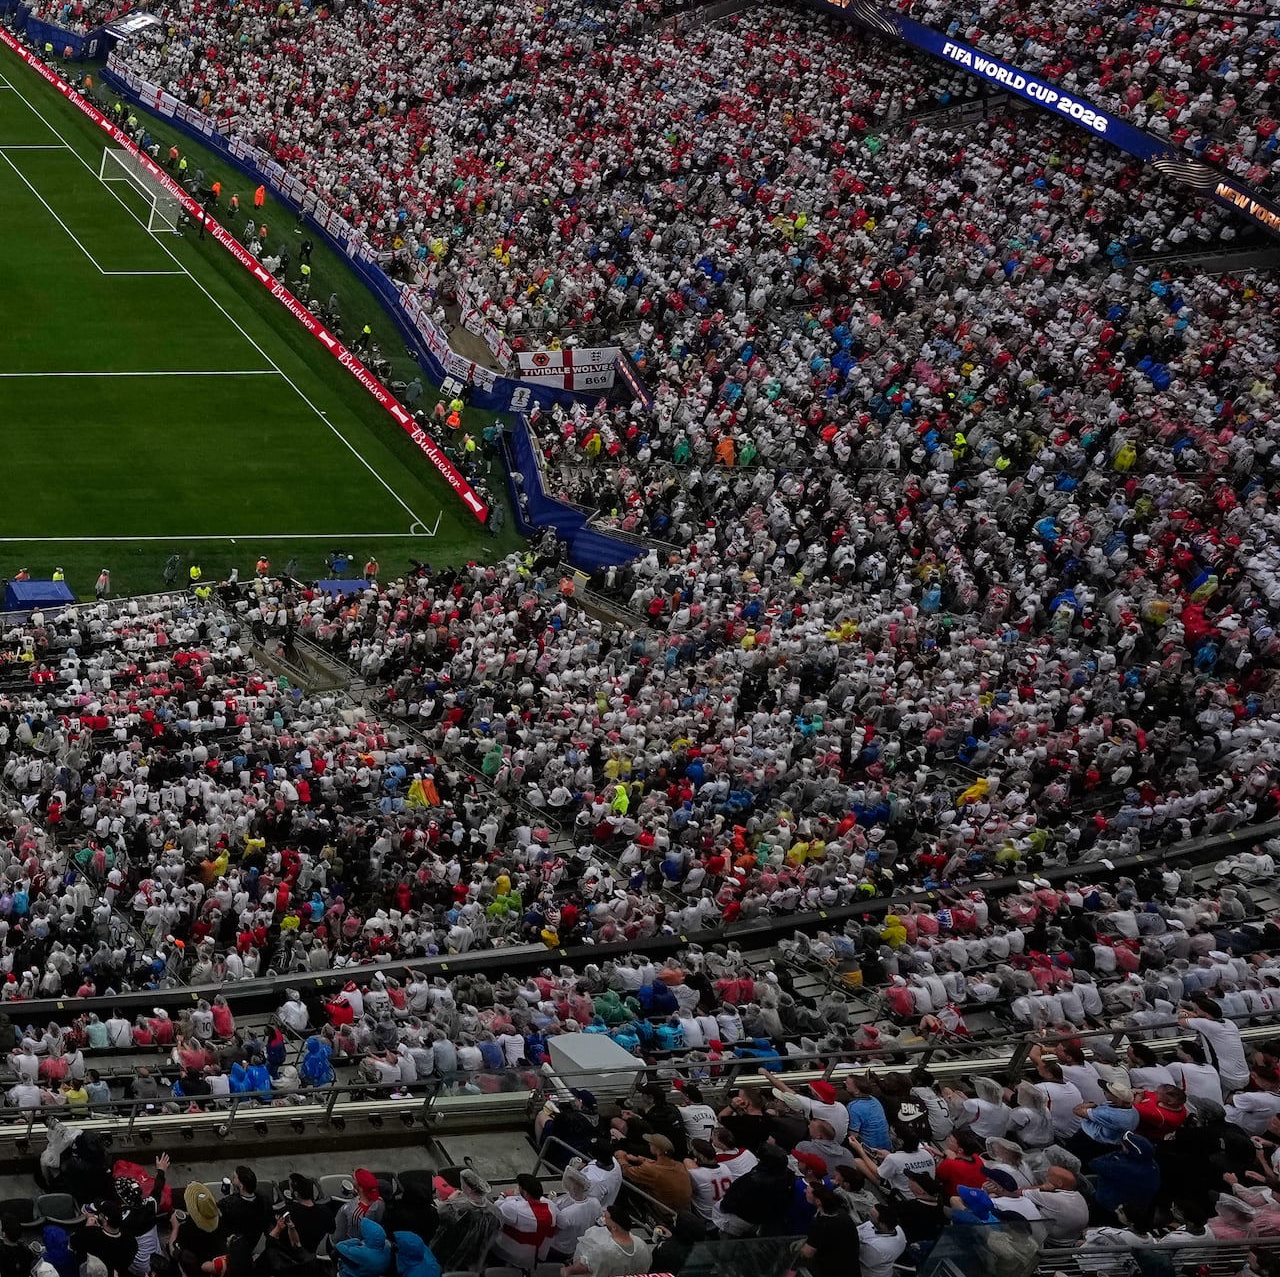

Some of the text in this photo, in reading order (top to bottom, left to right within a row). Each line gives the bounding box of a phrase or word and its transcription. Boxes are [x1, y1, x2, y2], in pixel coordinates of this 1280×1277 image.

[26, 51, 55, 82] Budweiser
[68, 88, 100, 122] Budweiser
[942, 42, 1108, 134] FIFA WORLD CUP 2026
[159, 172, 195, 212] Budweiser
[1214, 182, 1251, 210] NEW
[212, 221, 252, 267] Budweiser
[271, 279, 316, 330] Budweiser
[338, 345, 387, 403] Budweiser
[523, 364, 615, 377] TIVIDALE WOLVES
[586, 376, 607, 385] B69
[411, 422, 461, 488] Budweiser
